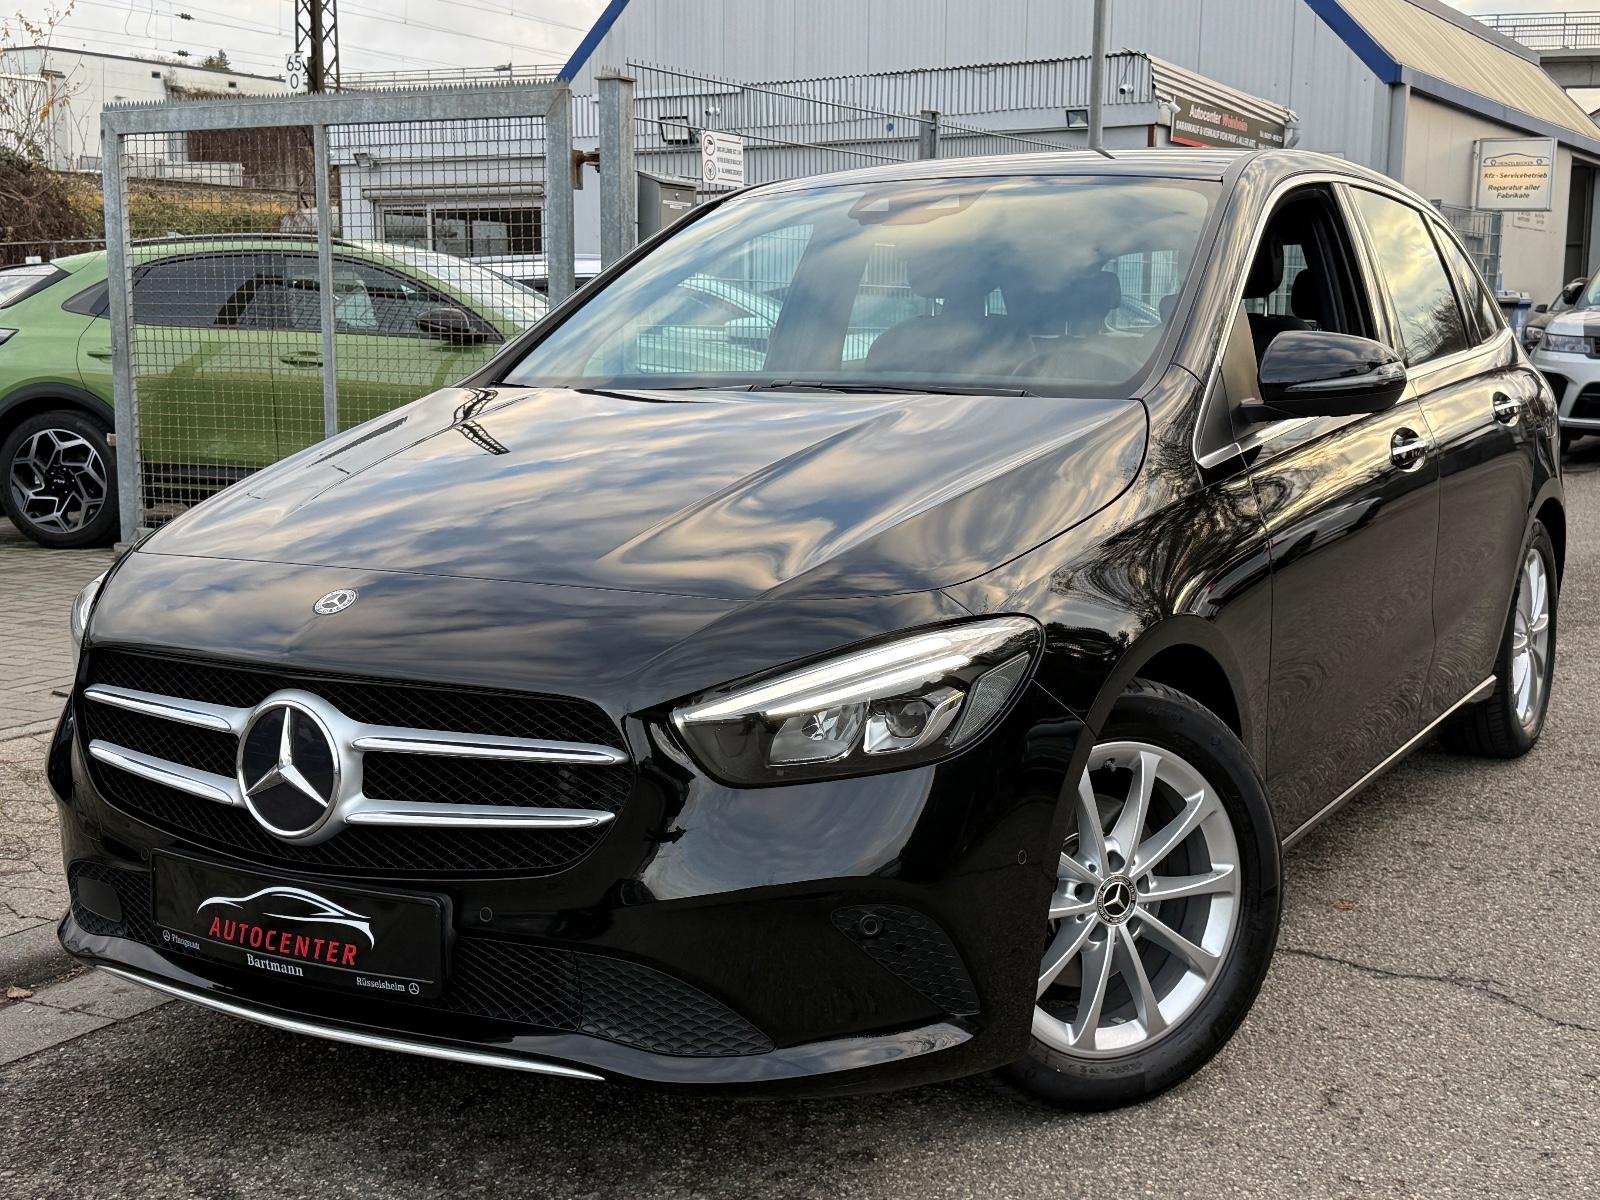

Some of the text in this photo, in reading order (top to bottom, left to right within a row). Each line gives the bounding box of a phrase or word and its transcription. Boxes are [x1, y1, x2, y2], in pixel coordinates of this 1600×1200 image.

[286, 55, 301, 71] 65
[290, 73, 299, 89] 0
[1189, 103, 1222, 125] Autocenter
[208, 915, 358, 966] AUTOCENTER
[247, 954, 304, 977] Bartmann
[356, 976, 406, 992] Rüsselsheim
